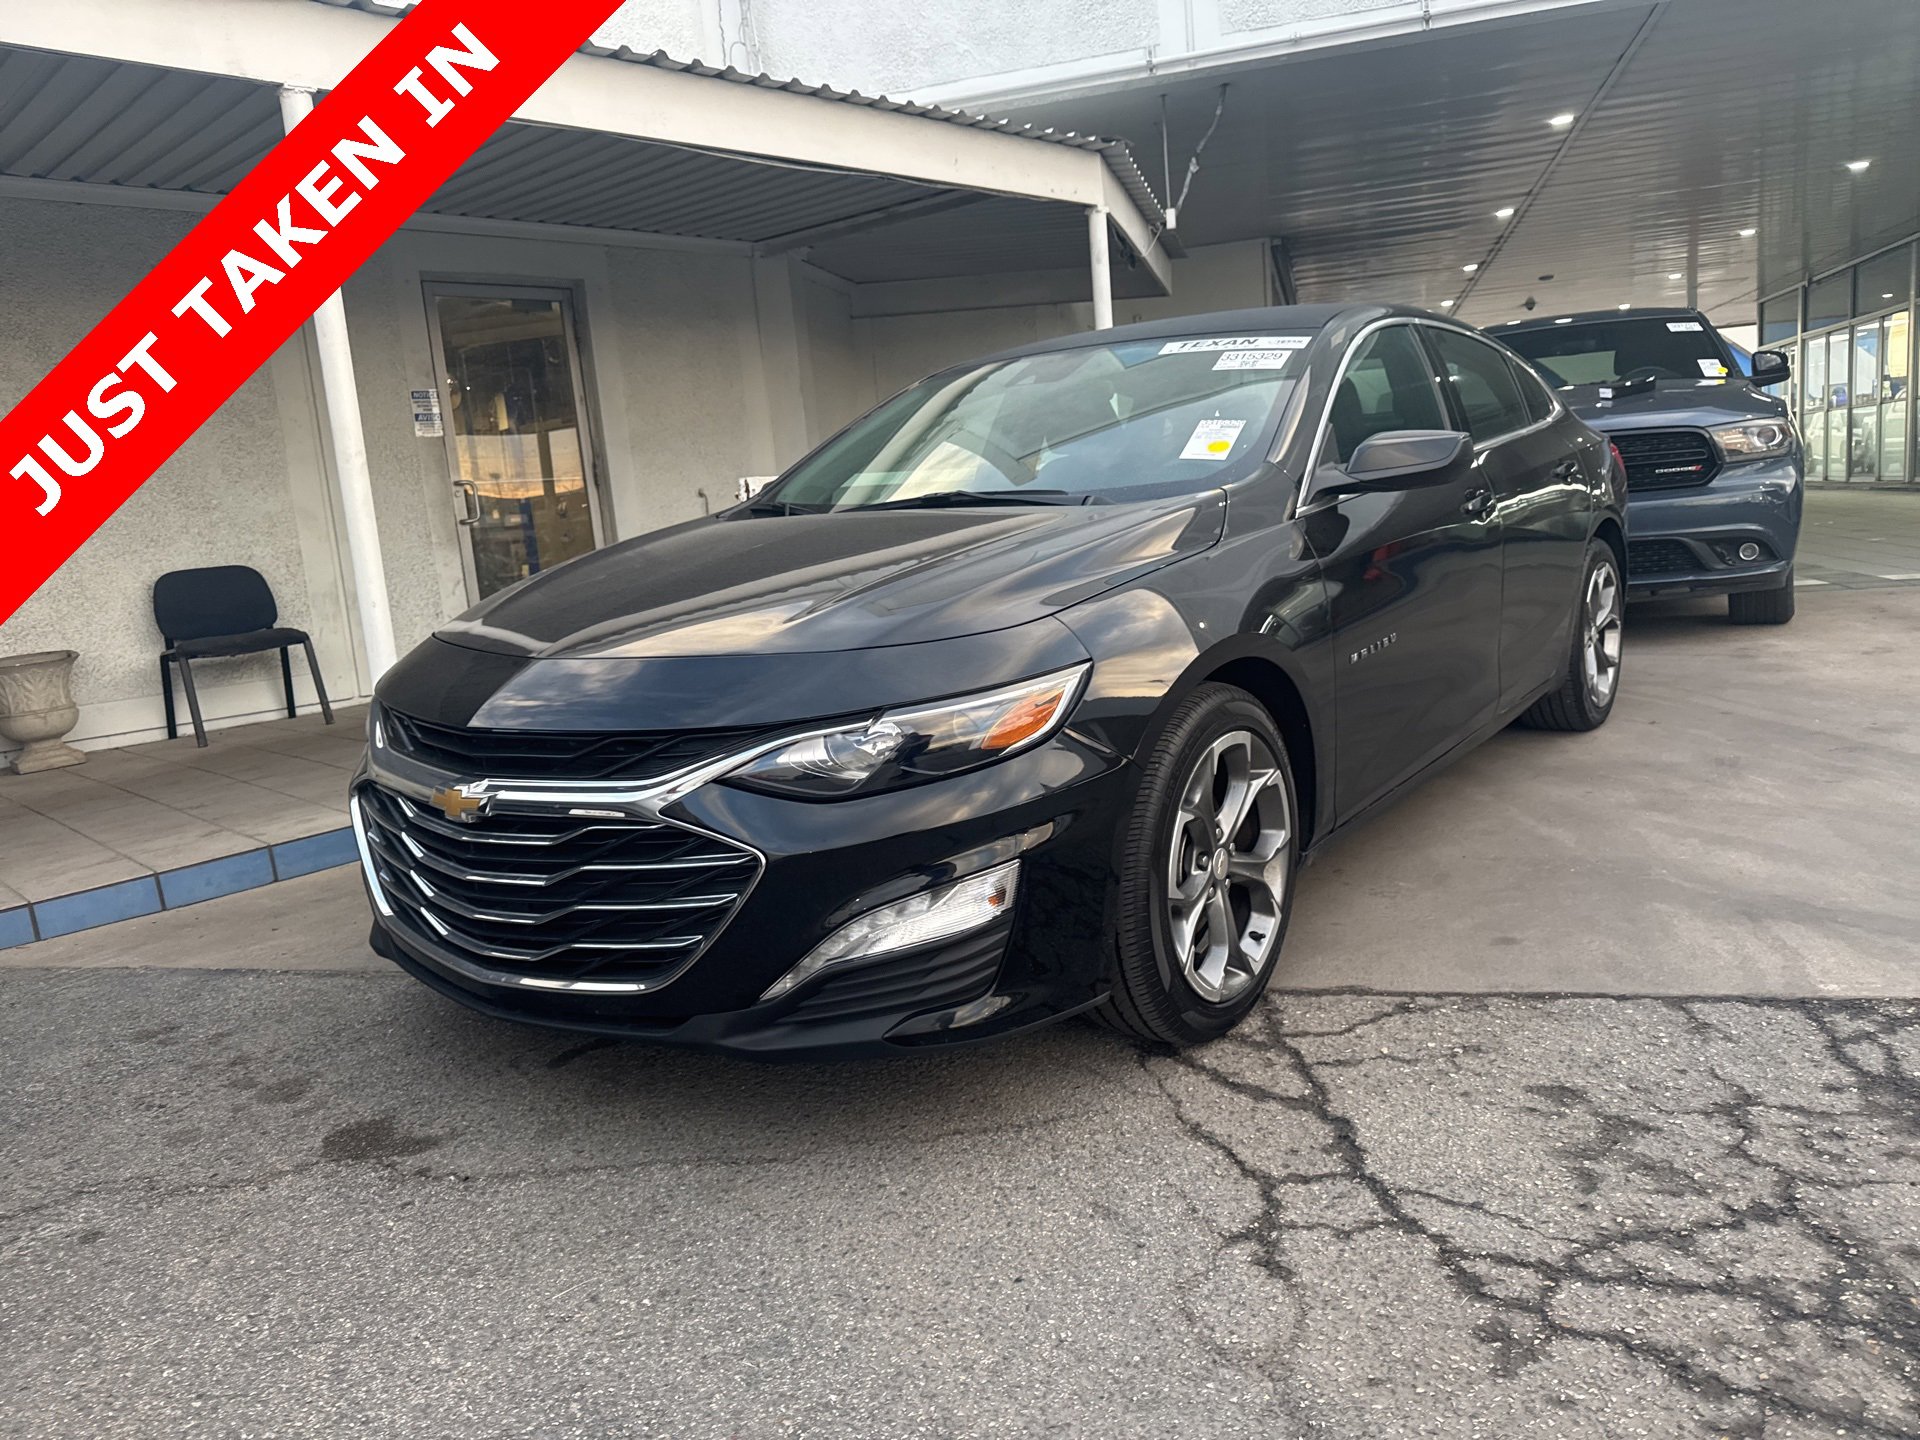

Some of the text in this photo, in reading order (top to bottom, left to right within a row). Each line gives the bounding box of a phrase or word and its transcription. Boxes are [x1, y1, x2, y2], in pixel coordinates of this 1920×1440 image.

[1179, 338, 1260, 349] TEXAN
[1220, 352, 1284, 361] 3315329
[418, 413, 441, 421] AVISO
[1655, 465, 1696, 474] DODGE
[1350, 632, 1397, 665] MALIBU
